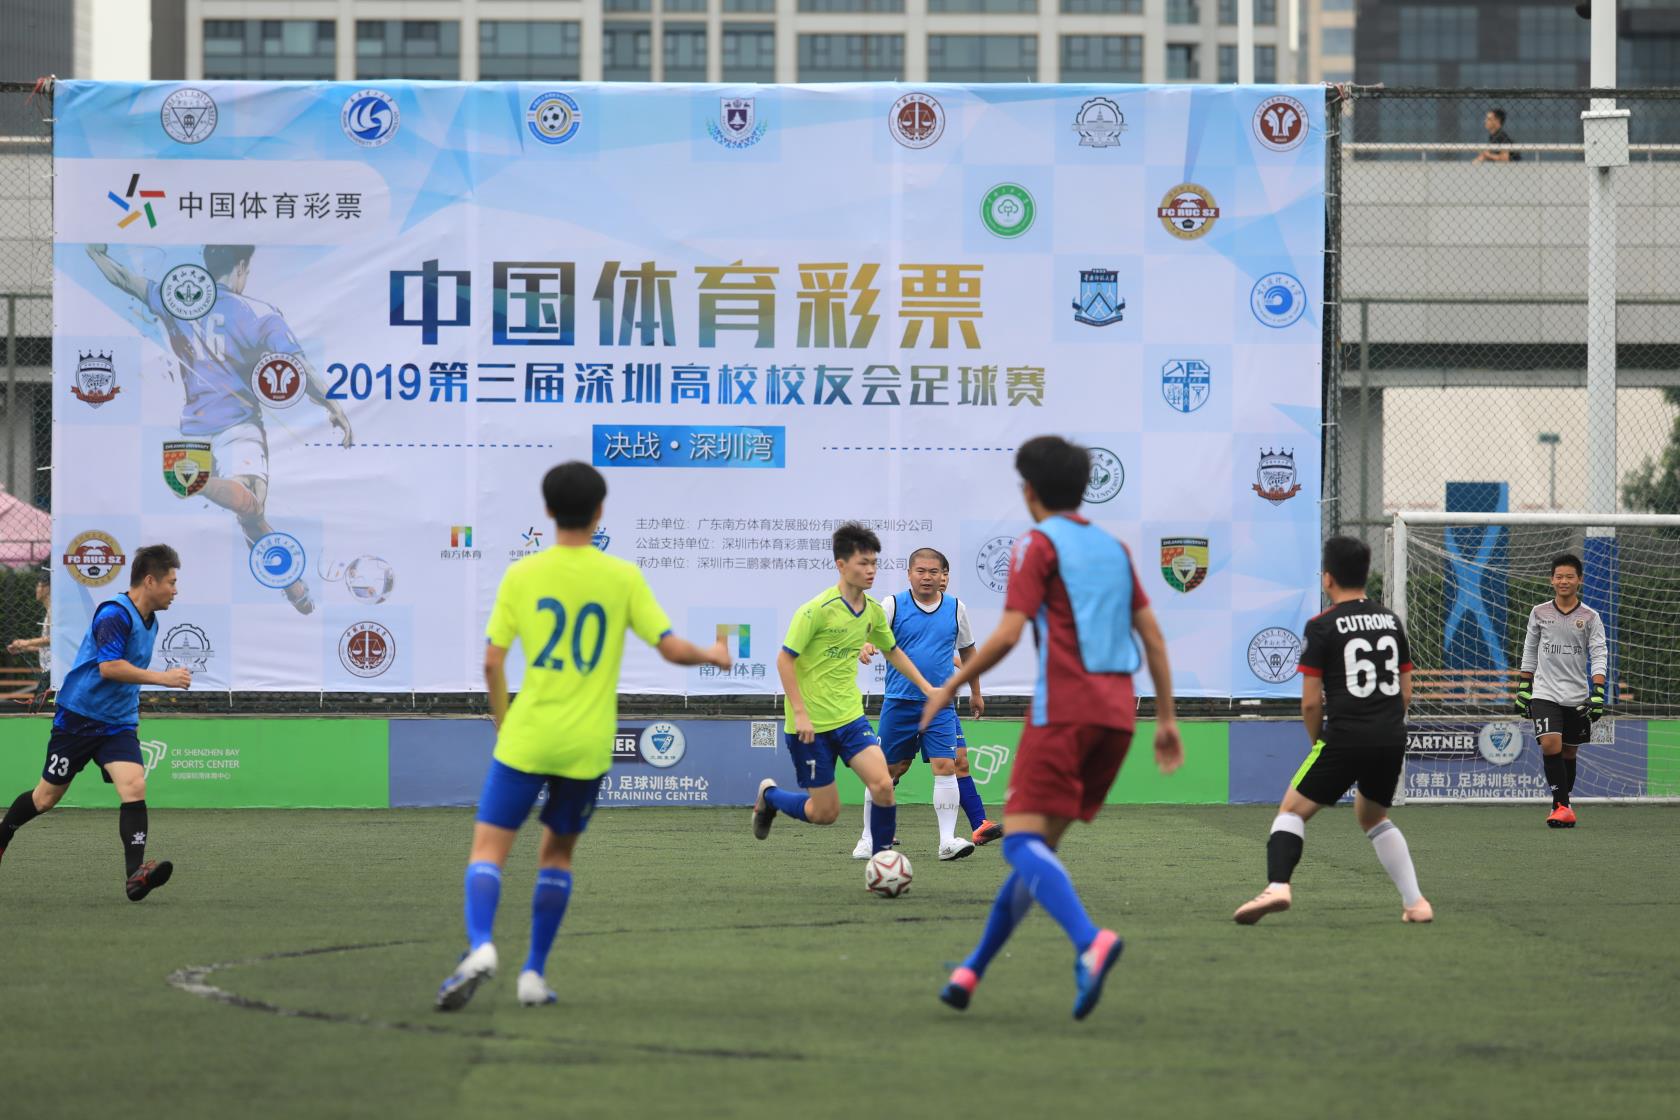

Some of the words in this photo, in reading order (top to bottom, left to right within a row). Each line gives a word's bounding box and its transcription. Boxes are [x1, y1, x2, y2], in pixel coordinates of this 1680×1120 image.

[179, 192, 362, 220] 中国体育彩票
[1162, 208, 1175, 217] FC
[1202, 208, 1216, 217] SZ
[390, 258, 984, 349] 中国体育彩票
[326, 362, 1047, 407] 2019第三届深圳高校校友会足球赛
[67, 556, 81, 564] FC
[108, 556, 122, 564] SZ
[1336, 614, 1397, 633] CUTRONE
[532, 597, 607, 675] 20
[699, 662, 767, 677] 南方体育
[1343, 635, 1400, 698] 63
[1535, 717, 1550, 734] 51
[47, 753, 70, 777] 23
[171, 760, 204, 768] SPORTS
[206, 760, 240, 768] CENTER
[805, 760, 816, 780] 7
[607, 792, 662, 800] TRAINING
[665, 792, 708, 800] CENTER
[1446, 789, 1500, 797] TRAINING
[1504, 789, 1546, 797] CENTER
